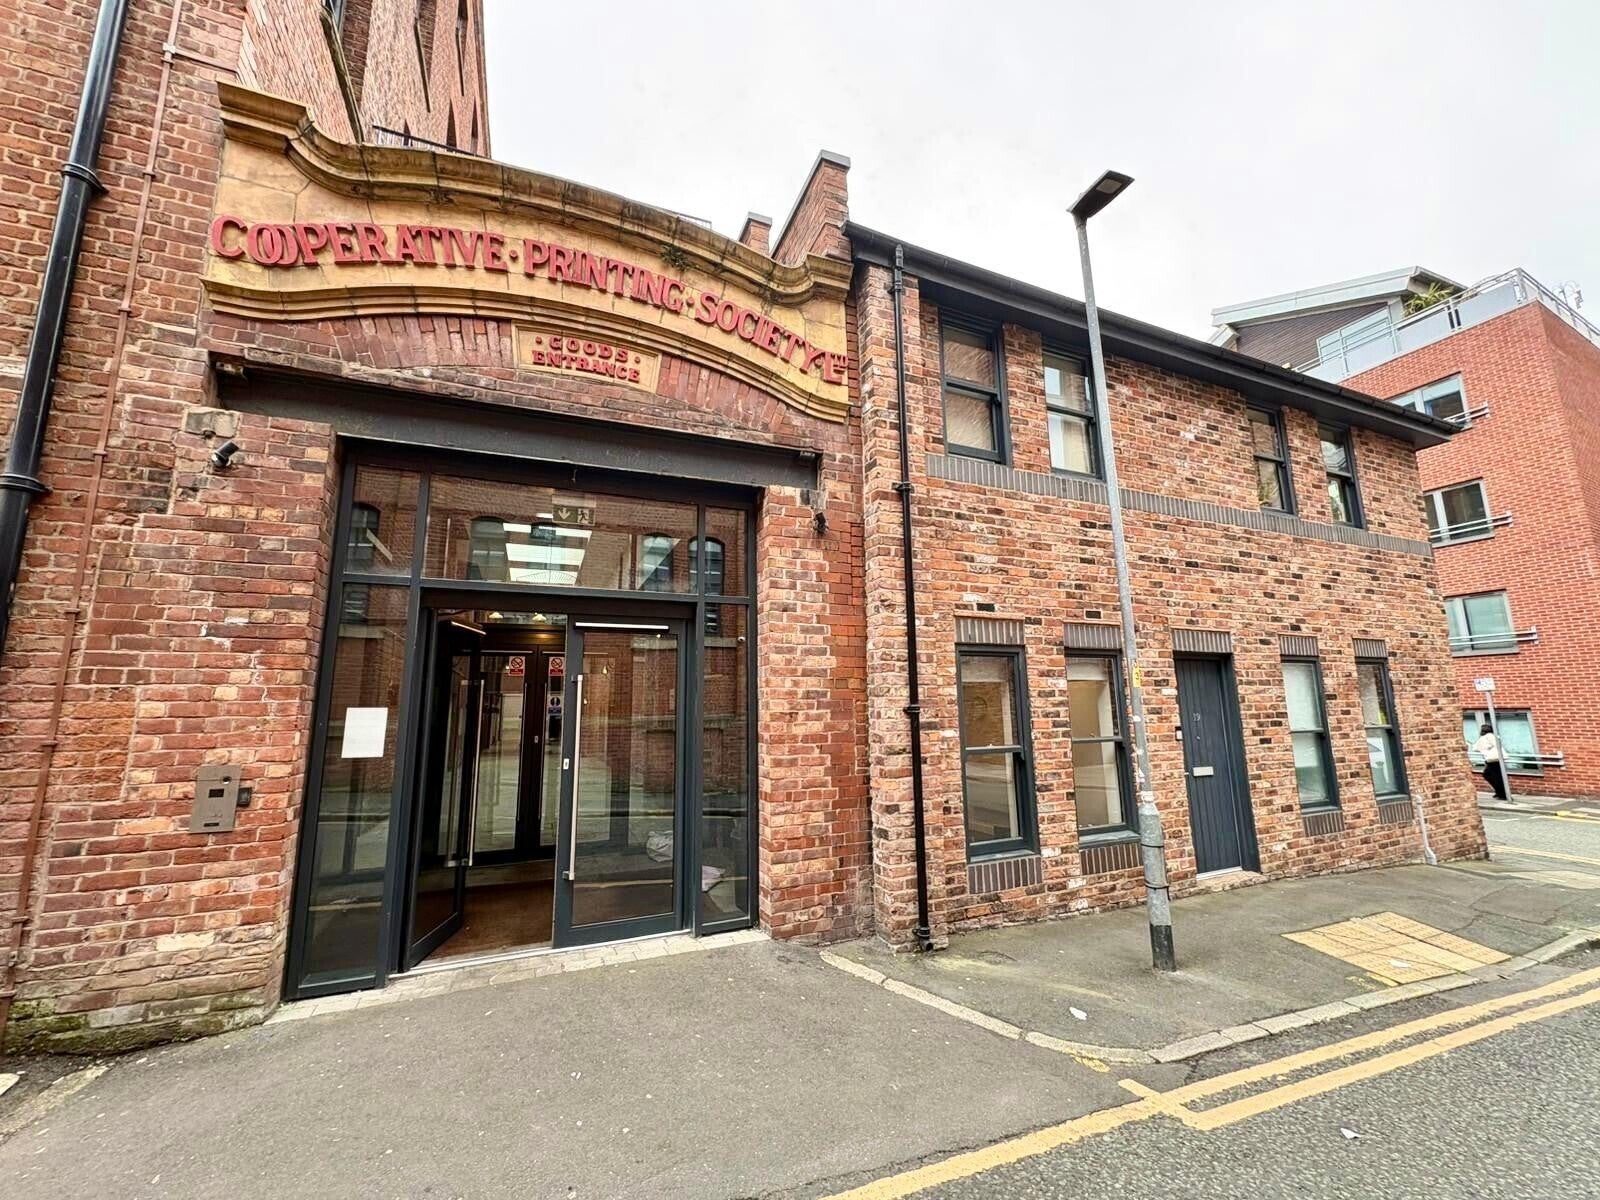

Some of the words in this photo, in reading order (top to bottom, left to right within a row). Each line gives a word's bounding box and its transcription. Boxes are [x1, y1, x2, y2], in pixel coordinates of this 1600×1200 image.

[210, 214, 508, 273] COOPERATIVE
[523, 239, 685, 314] PRINTING
[695, 290, 825, 375] SOCIETY
[549, 335, 629, 363] GOODS
[532, 350, 640, 383] ENTRANCE
